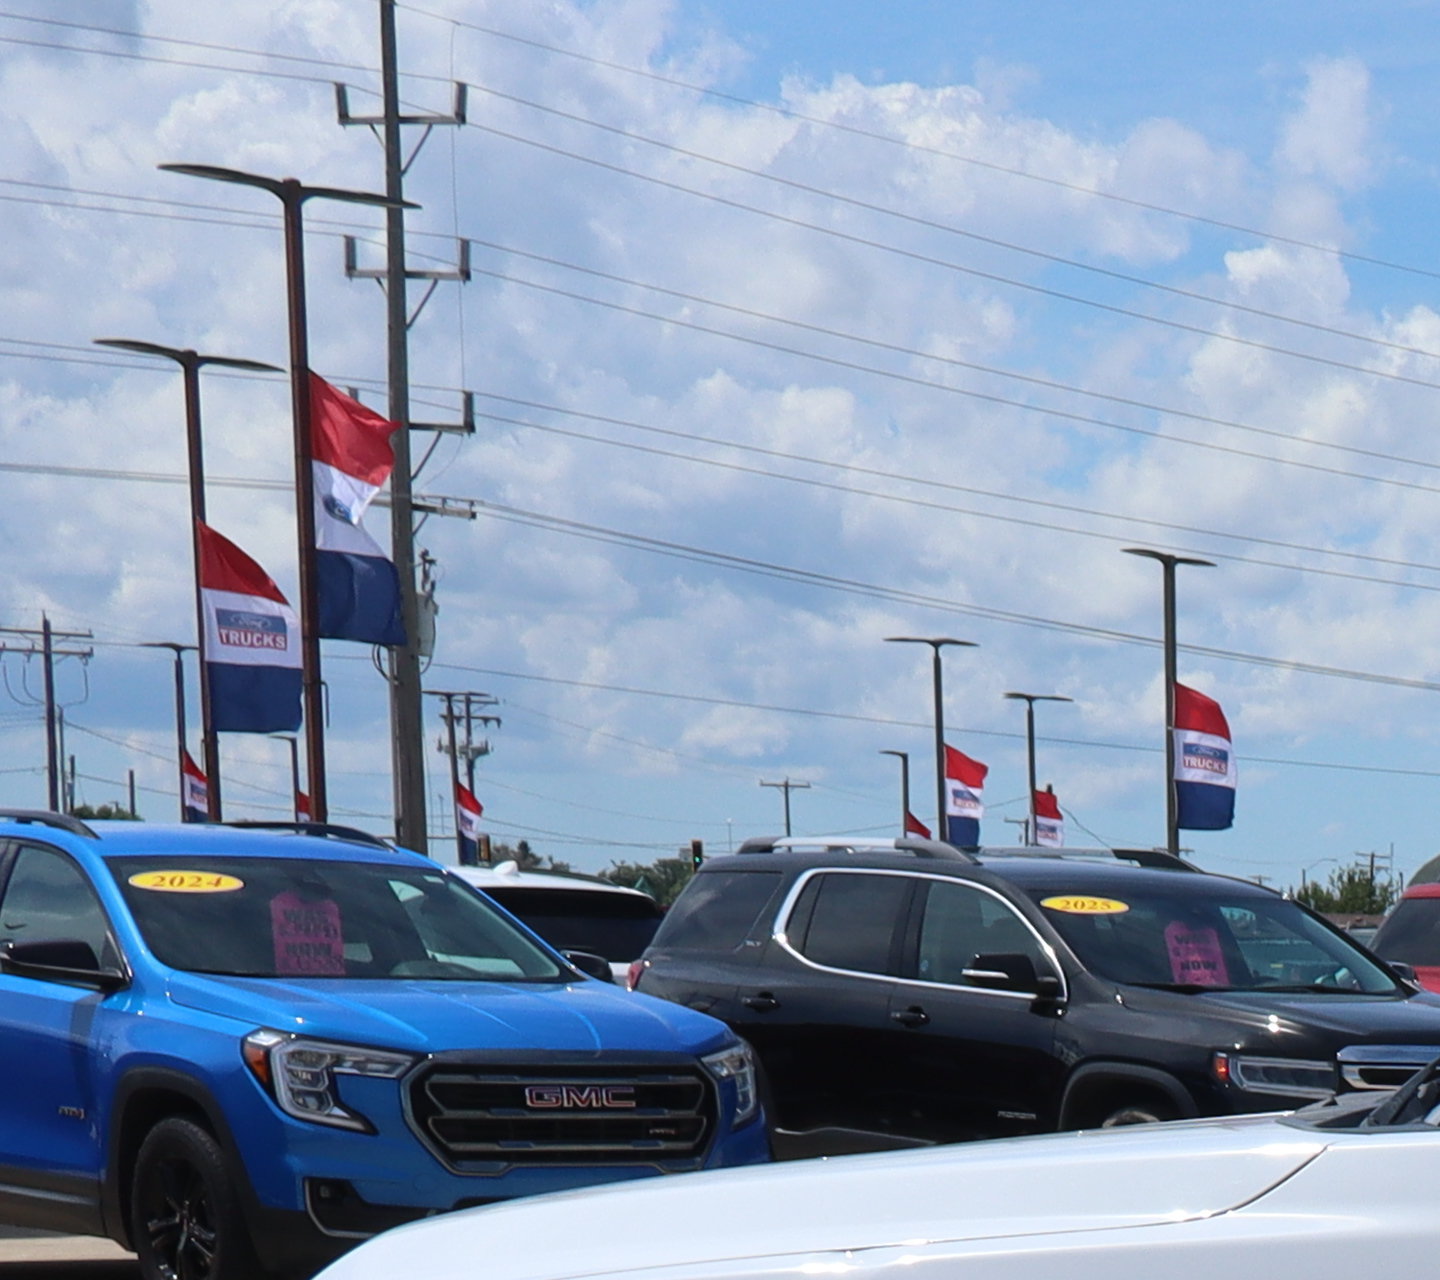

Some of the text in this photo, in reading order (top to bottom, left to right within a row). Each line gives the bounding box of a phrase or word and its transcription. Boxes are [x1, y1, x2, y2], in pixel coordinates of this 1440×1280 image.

[219, 628, 286, 649] TRUCKS
[1183, 755, 1226, 773] TRUCKS
[151, 875, 223, 888] 2024
[1060, 899, 1112, 910] 2025
[525, 1086, 637, 1108] GMC
